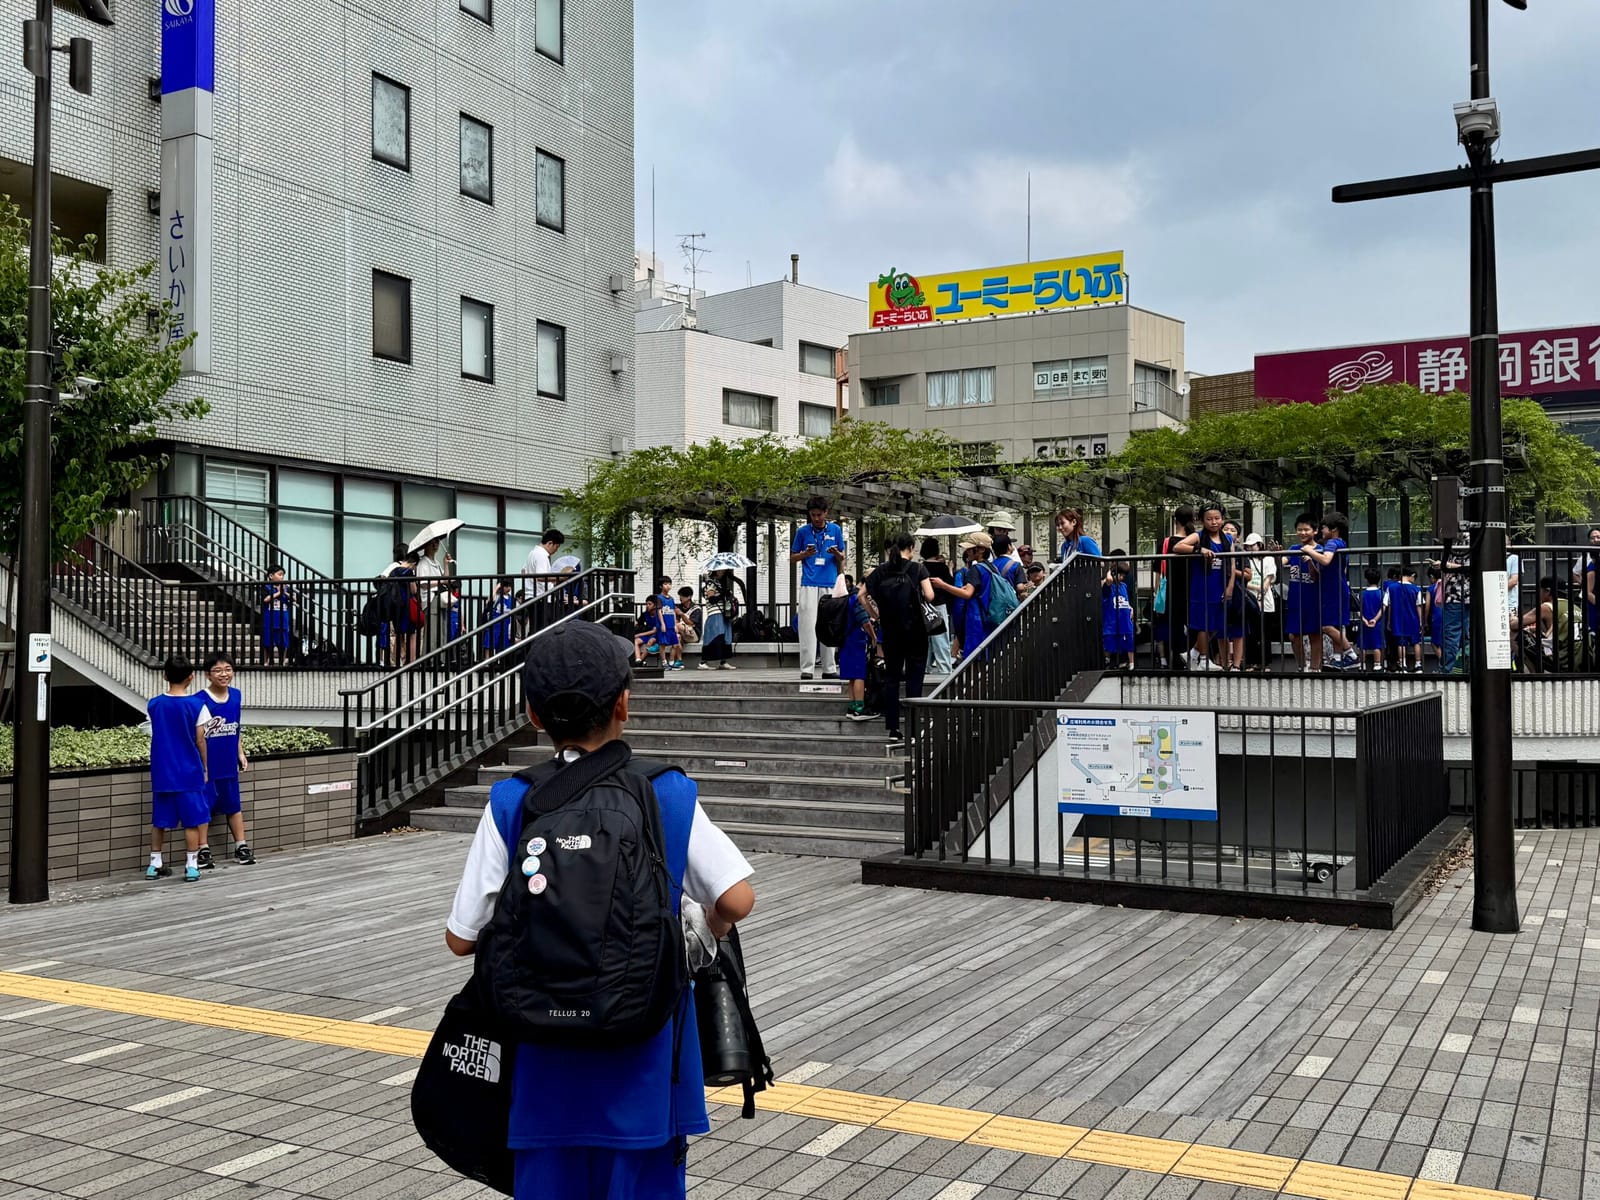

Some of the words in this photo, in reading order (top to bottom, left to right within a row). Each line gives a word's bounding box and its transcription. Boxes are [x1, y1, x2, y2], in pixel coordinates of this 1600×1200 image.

[165, 16, 193, 30] SAIKAYA
[936, 264, 1122, 315] ユーミーらいふ
[876, 310, 928, 324] ユーミーらいふ
[549, 1009, 577, 1017] TELLUS
[463, 1033, 490, 1053] THE
[442, 1042, 487, 1066] NORTH
[450, 1058, 485, 1079] FACE
